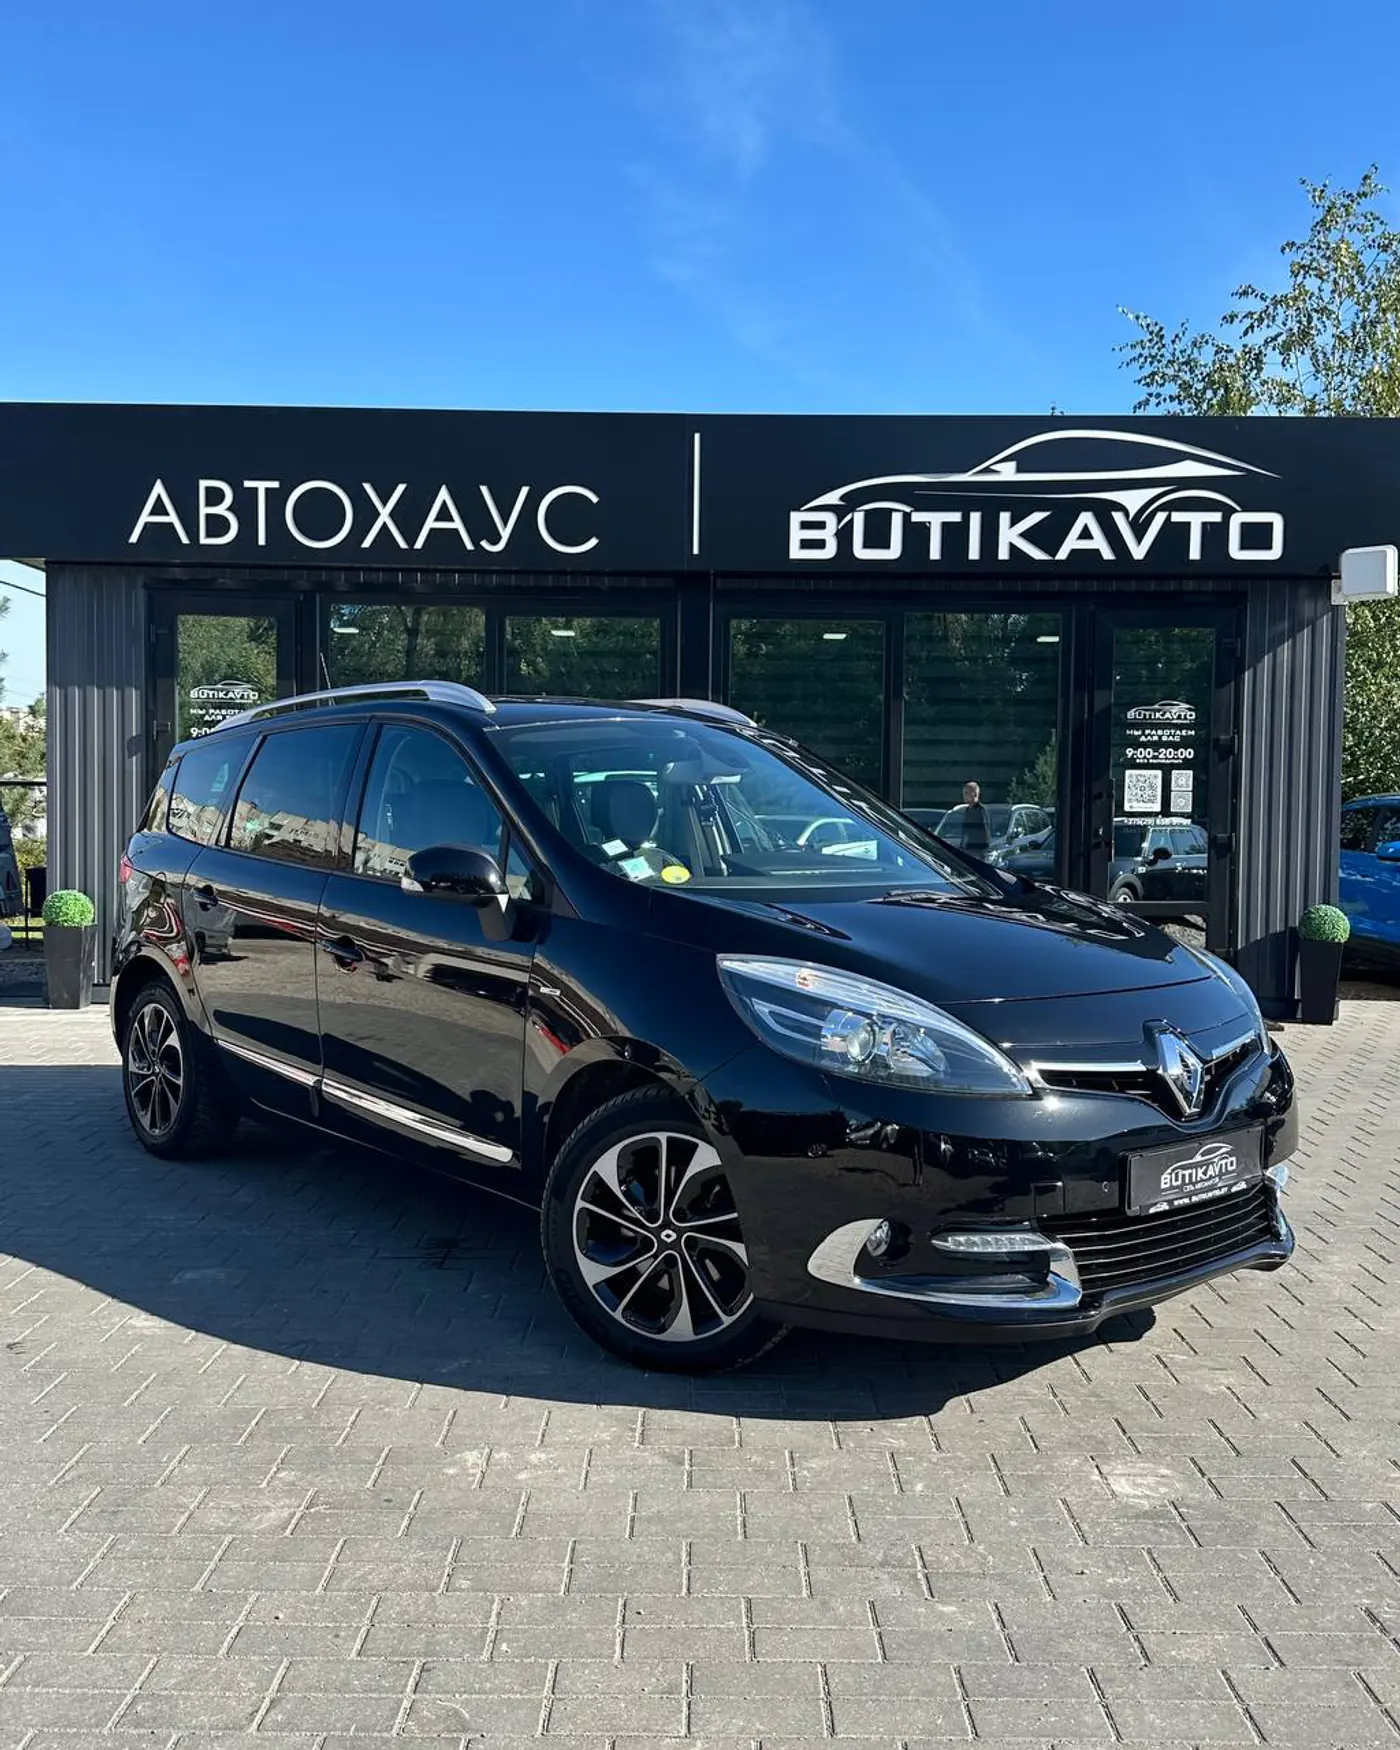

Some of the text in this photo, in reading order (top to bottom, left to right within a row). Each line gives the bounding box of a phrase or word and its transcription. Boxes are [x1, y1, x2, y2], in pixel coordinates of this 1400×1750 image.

[128, 478, 600, 554] АВТОХАУС
[789, 509, 1284, 561] BUTIKAVTO
[190, 690, 259, 700] BUTIKAVTO
[1127, 710, 1196, 720] BUTIKAVTO
[1126, 748, 1194, 759] 9:00-20:00
[1160, 1156, 1236, 1189] BUTIKAVTO
